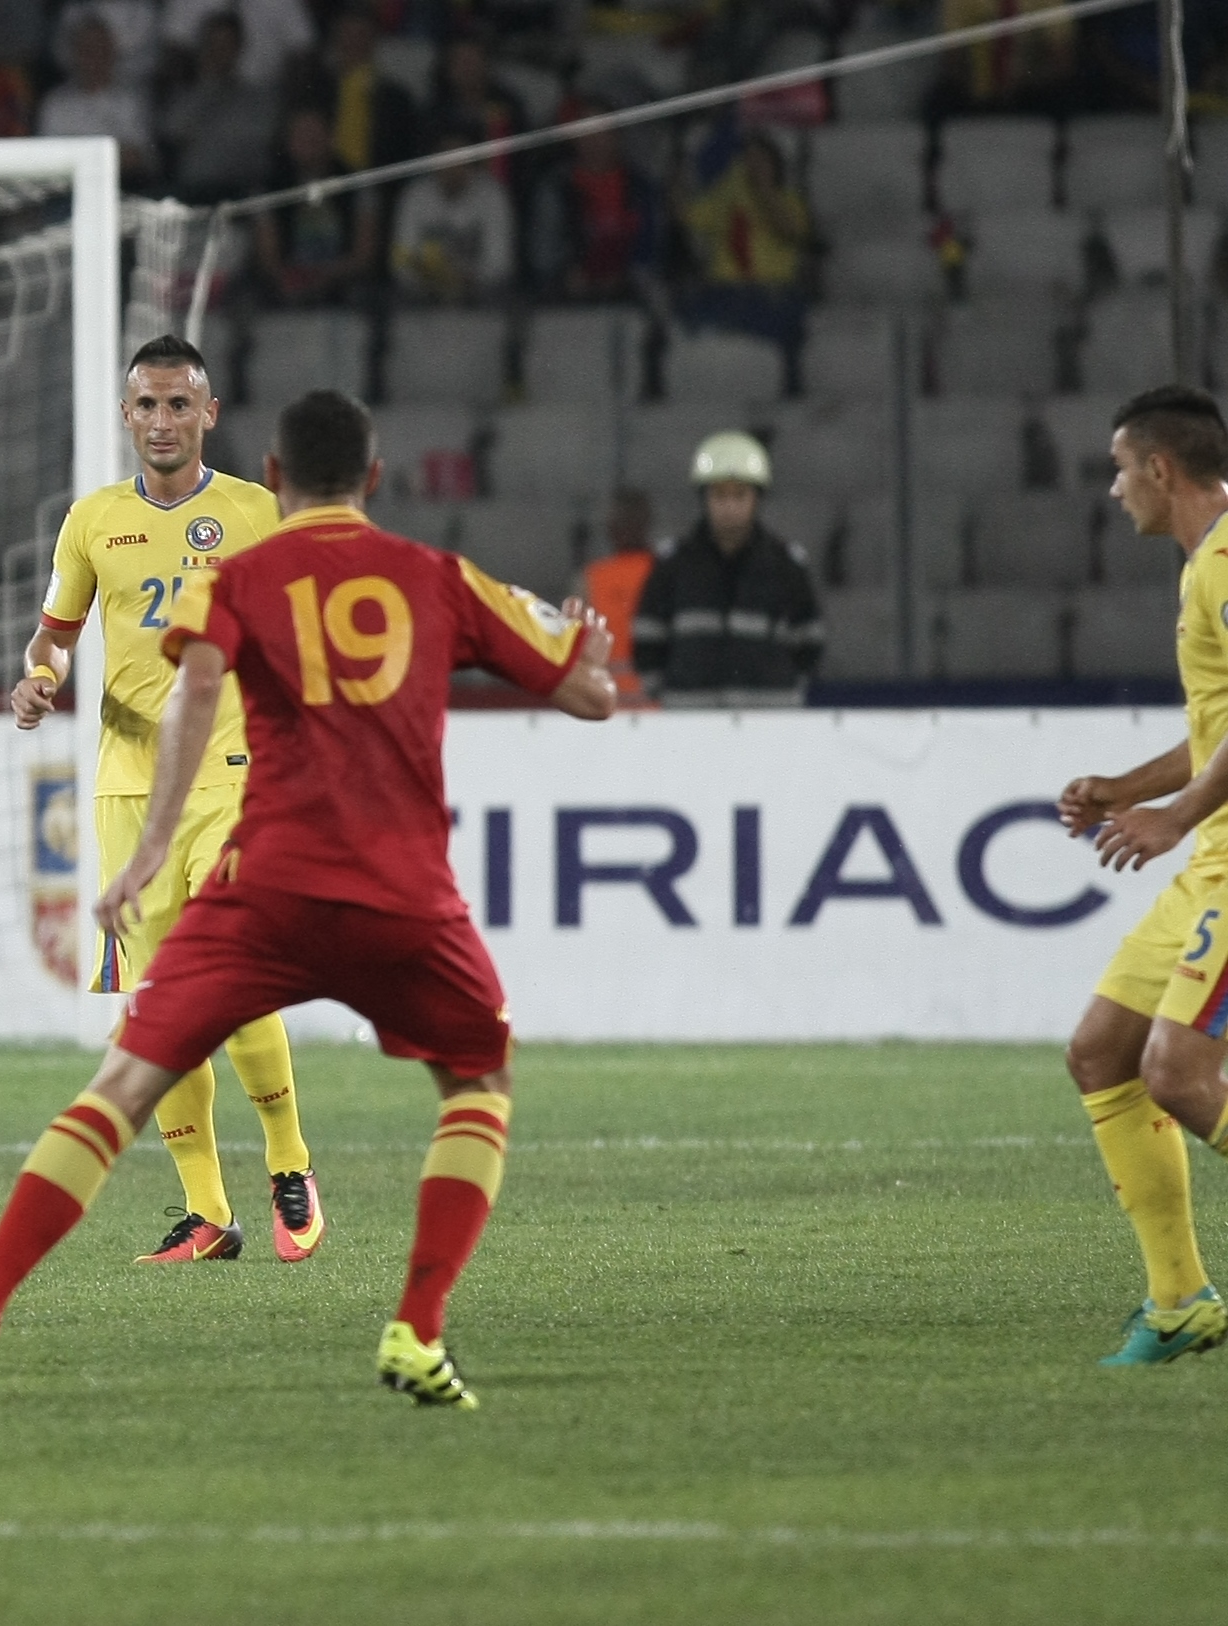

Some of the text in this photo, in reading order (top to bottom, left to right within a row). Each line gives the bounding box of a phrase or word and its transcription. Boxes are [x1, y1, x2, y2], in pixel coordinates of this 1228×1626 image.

[139, 576, 184, 628] 2
[284, 575, 413, 706] 19
[448, 799, 1112, 928] IRIAC
[1184, 908, 1220, 962] 5
